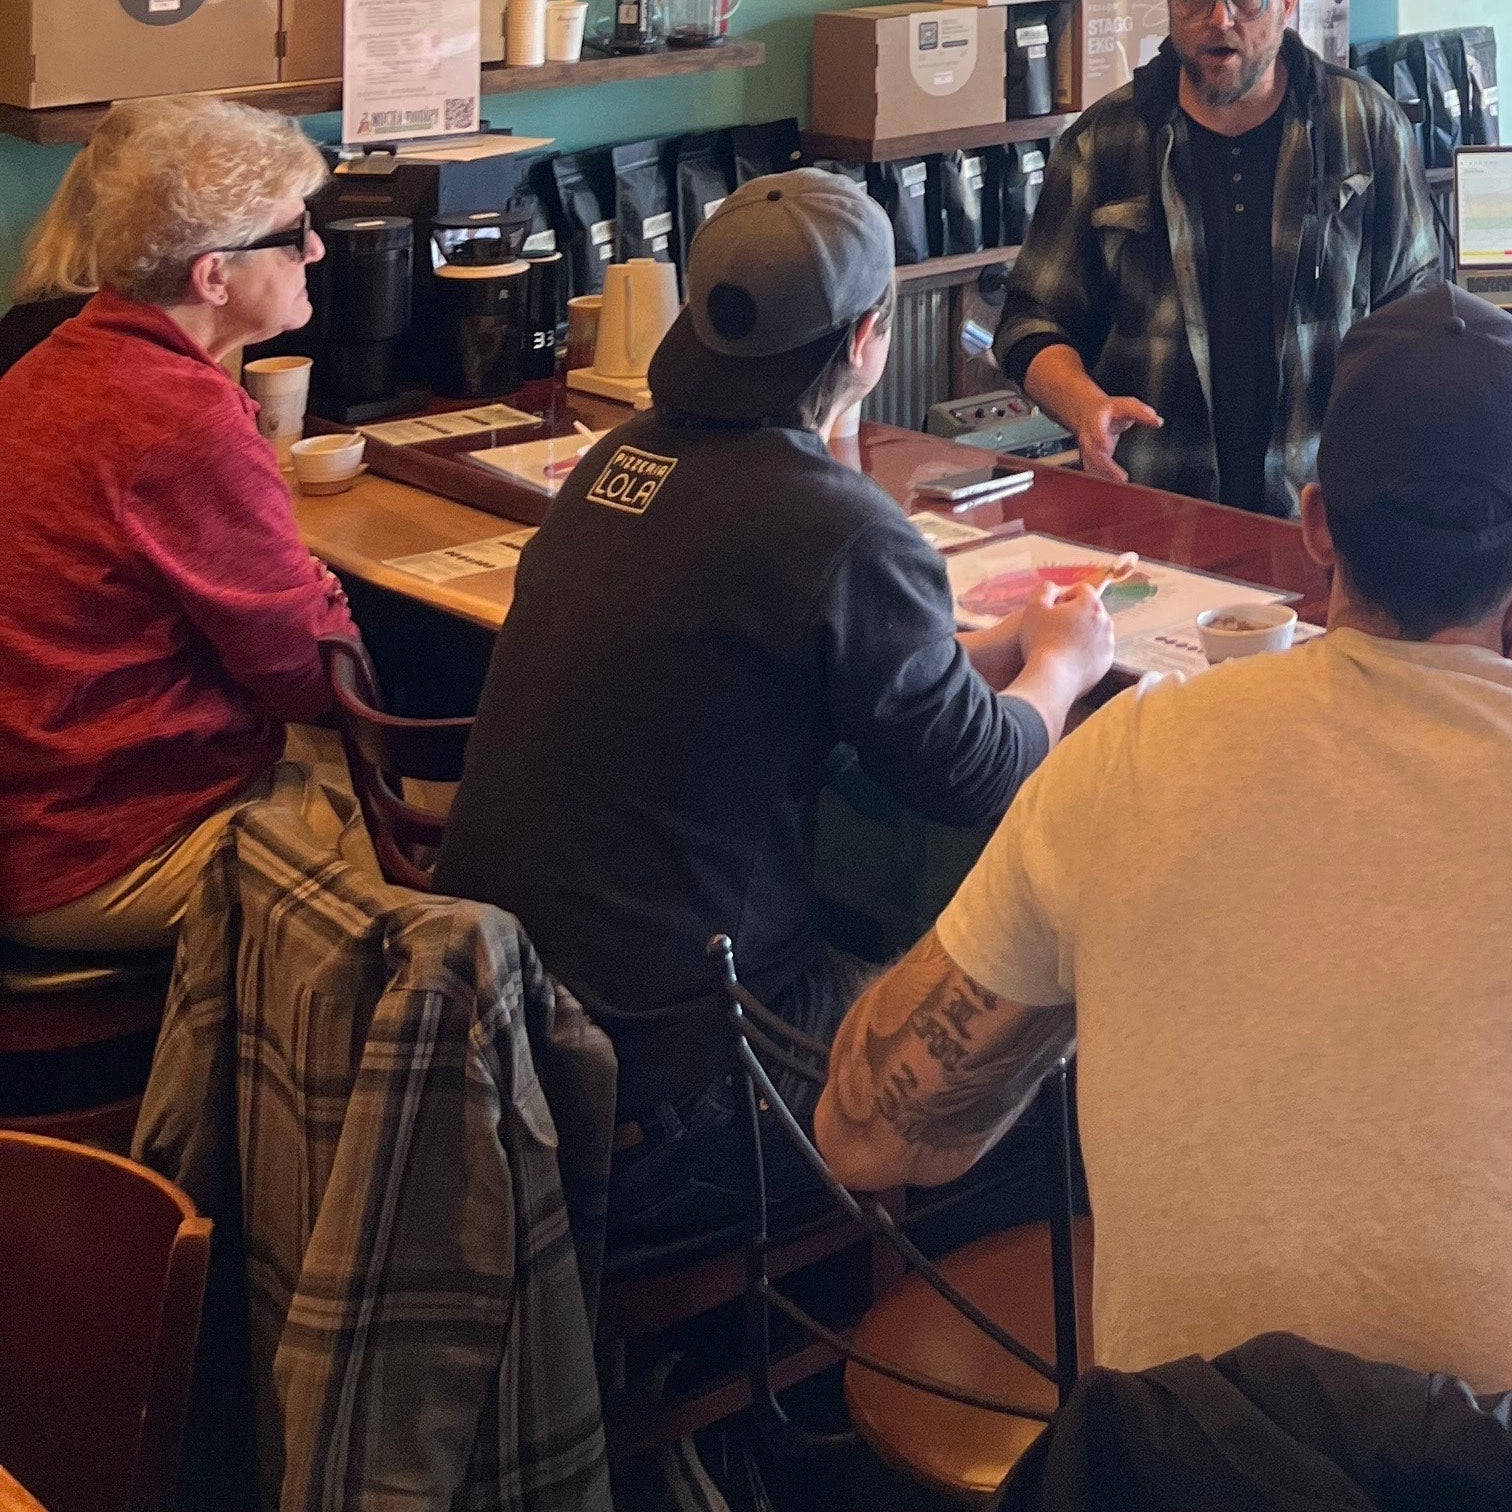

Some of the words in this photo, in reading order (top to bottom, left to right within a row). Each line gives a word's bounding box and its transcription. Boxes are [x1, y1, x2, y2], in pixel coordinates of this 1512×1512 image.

[1087, 16, 1133, 35] STAGG
[1087, 36, 1115, 55] EKG
[613, 452, 669, 477] PIZZERIA
[594, 468, 657, 506] LOLA
